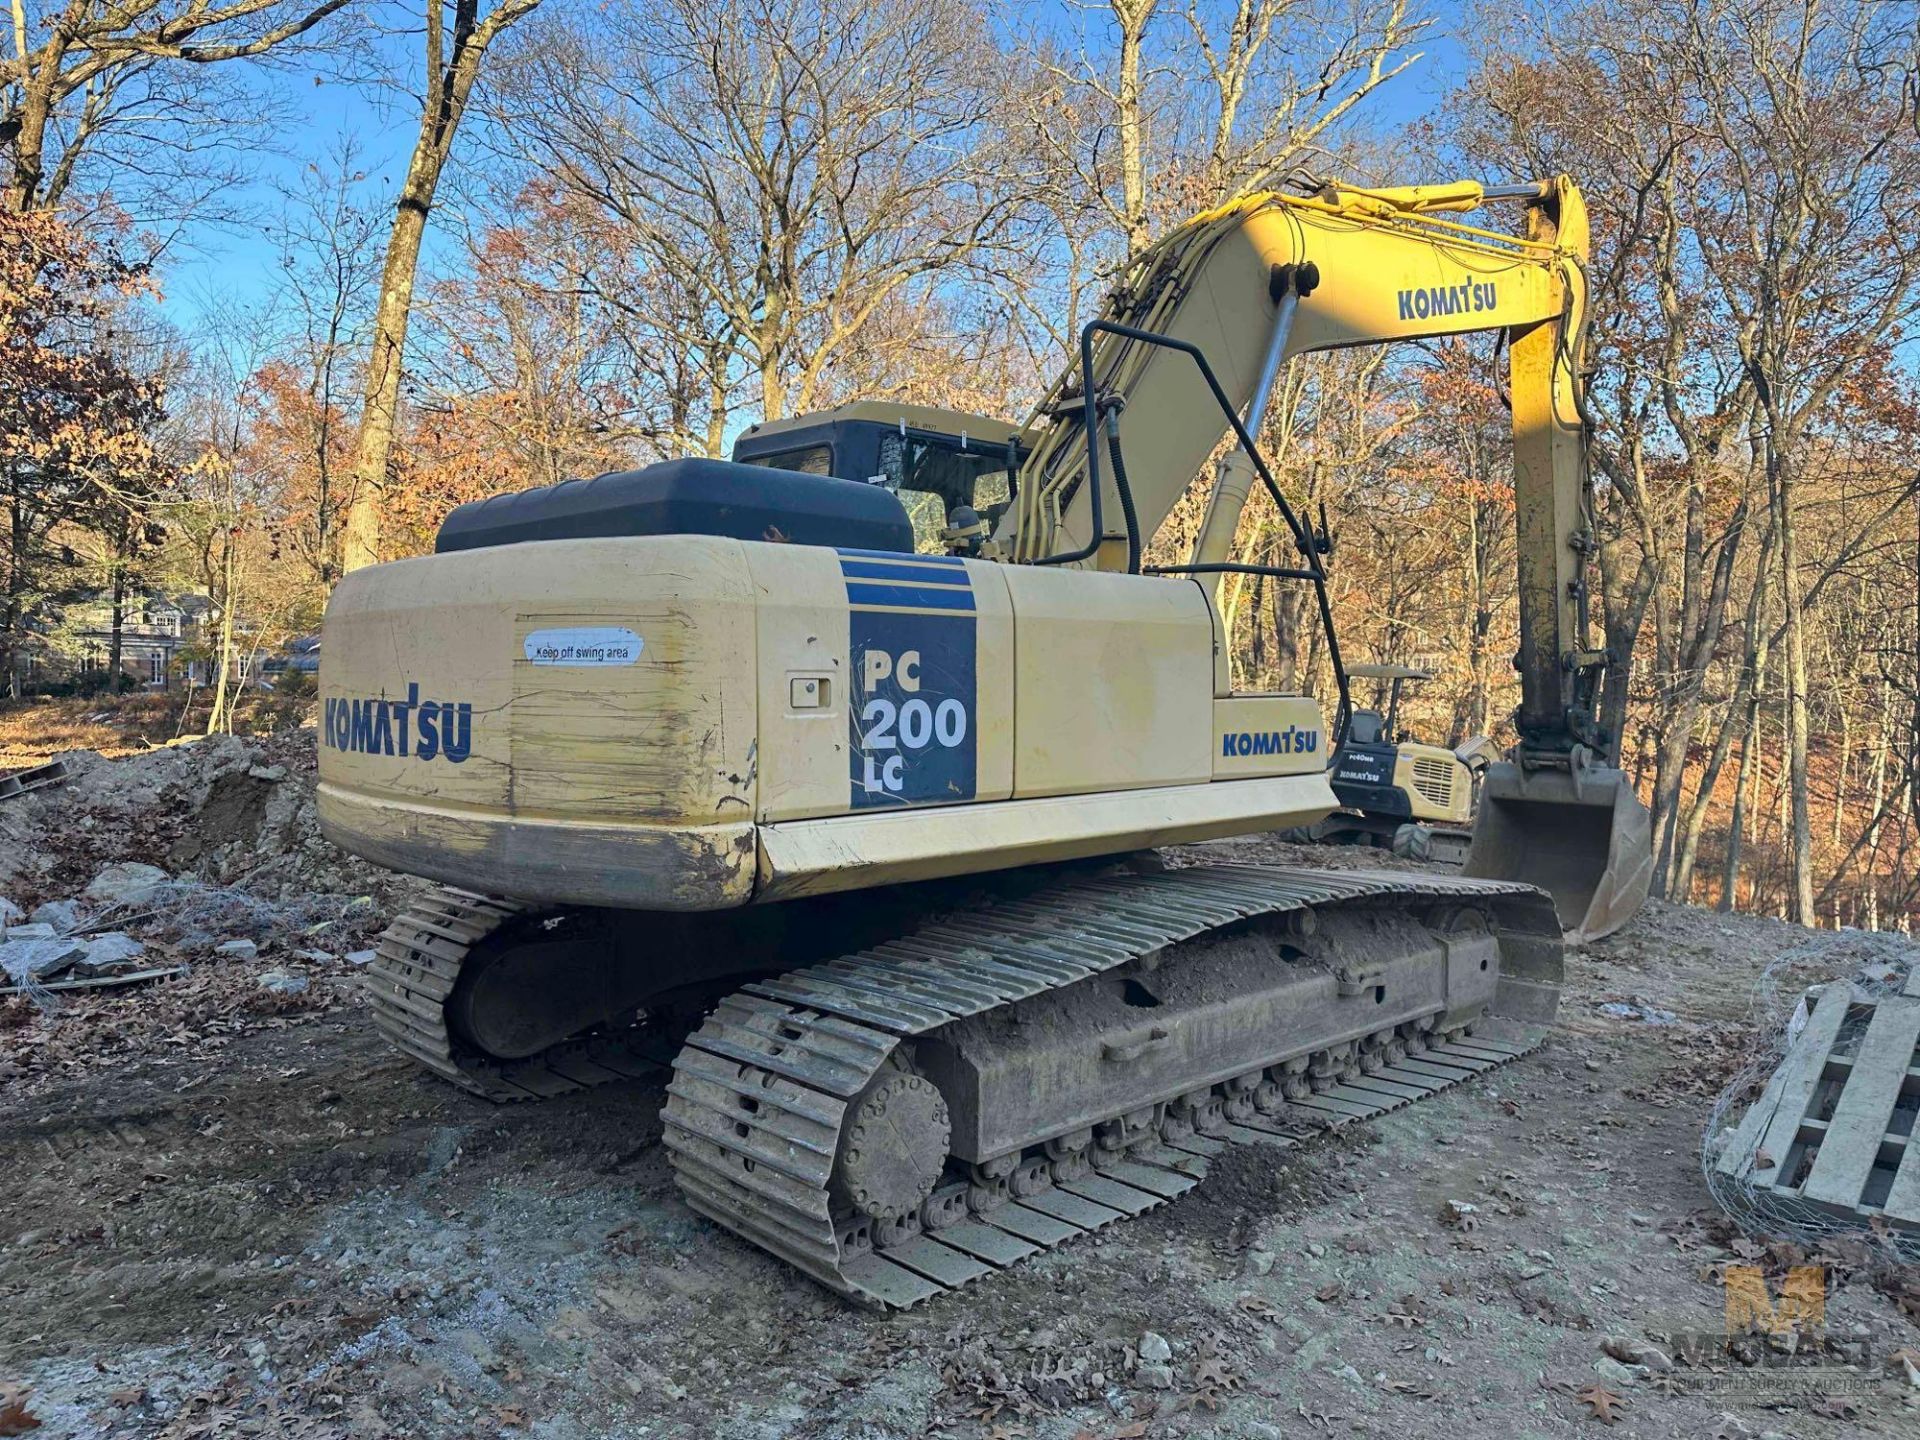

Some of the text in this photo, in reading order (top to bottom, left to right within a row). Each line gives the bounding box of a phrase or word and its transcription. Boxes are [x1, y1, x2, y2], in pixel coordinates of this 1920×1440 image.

[1397, 275, 1497, 320] KOMATSU
[536, 646, 629, 662] Keep off swing area
[864, 650, 920, 692] PC
[325, 682, 472, 763] KOMATSU
[861, 698, 967, 750] 200
[1223, 724, 1317, 757] KOMATSU
[864, 755, 903, 792] LC
[1340, 771, 1379, 782] KOMATSU
